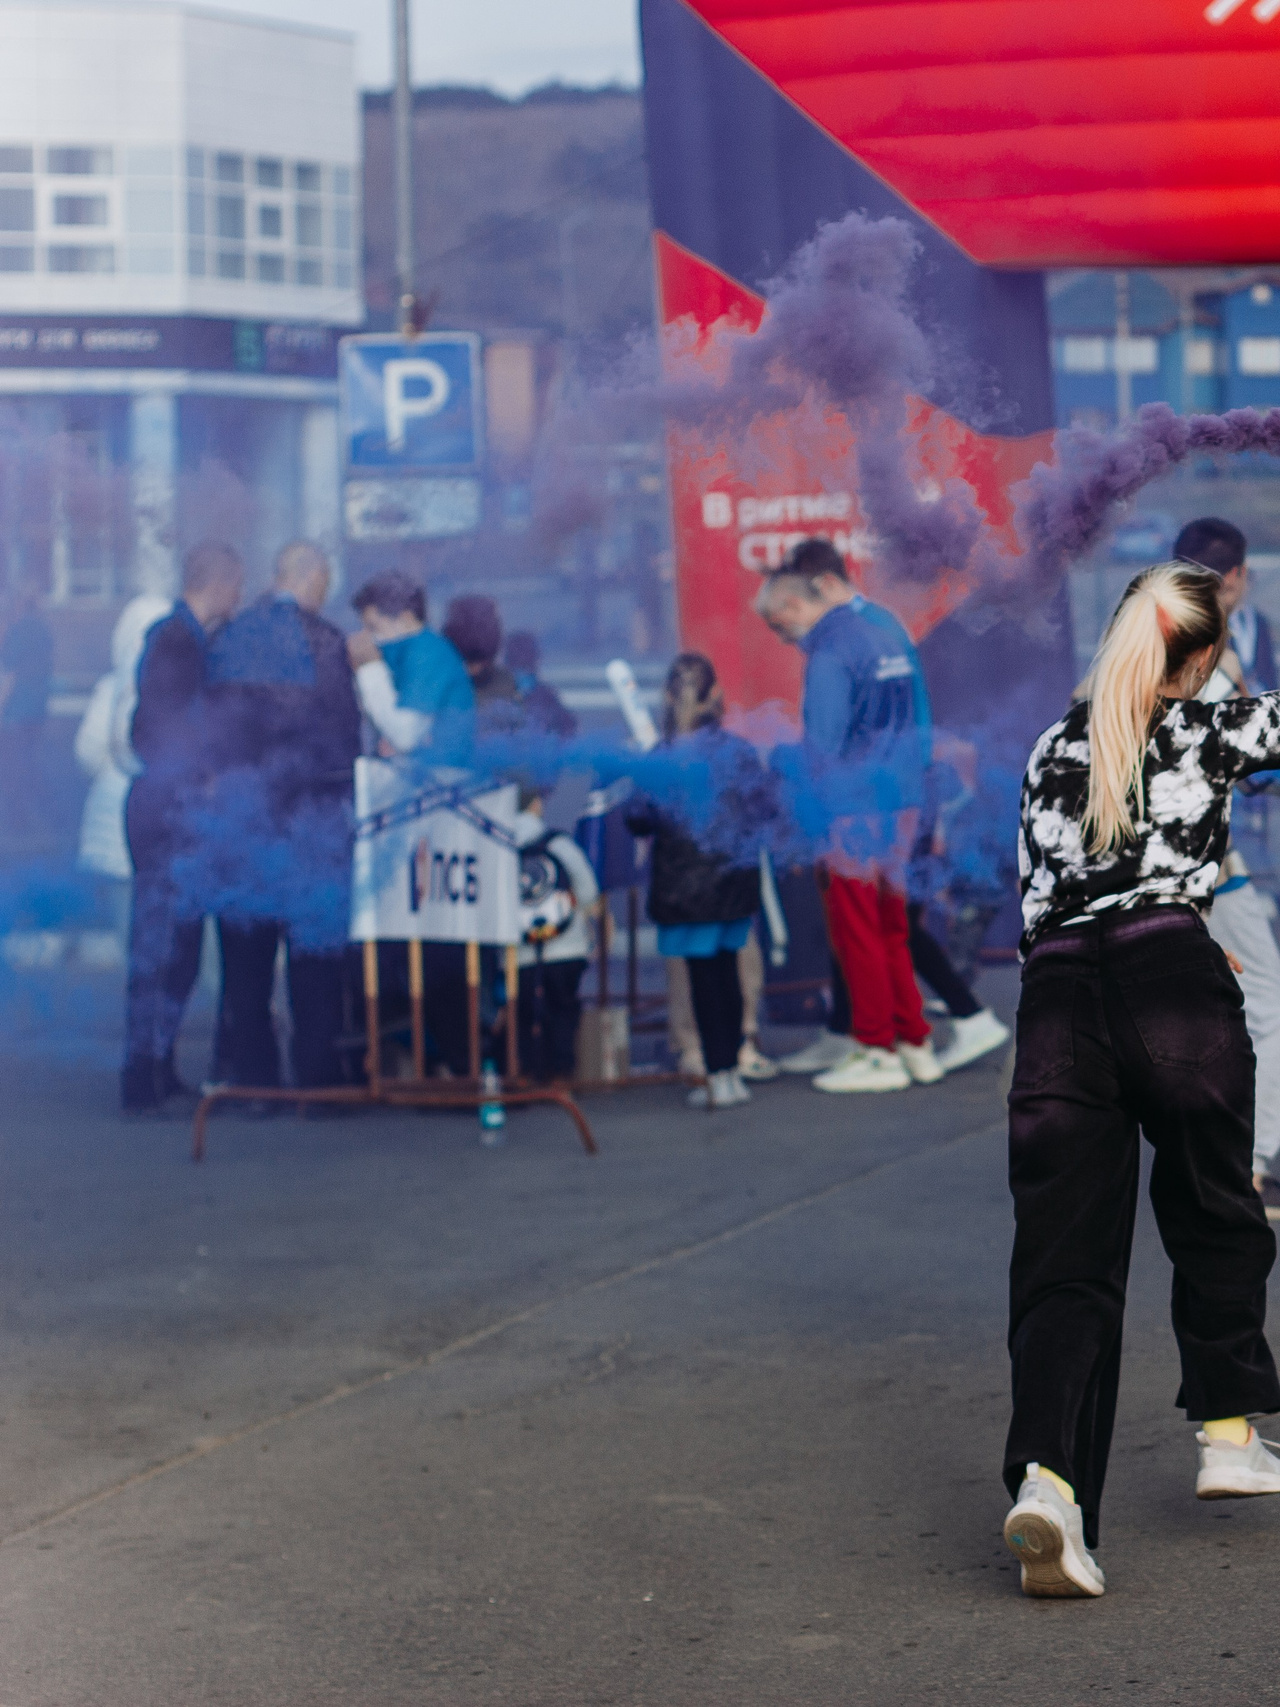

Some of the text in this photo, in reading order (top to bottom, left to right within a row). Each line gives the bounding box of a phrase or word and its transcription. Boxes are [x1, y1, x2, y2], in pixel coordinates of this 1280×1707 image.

[384, 359, 448, 453] P
[702, 491, 731, 529] В
[430, 851, 478, 903] ПСБ
